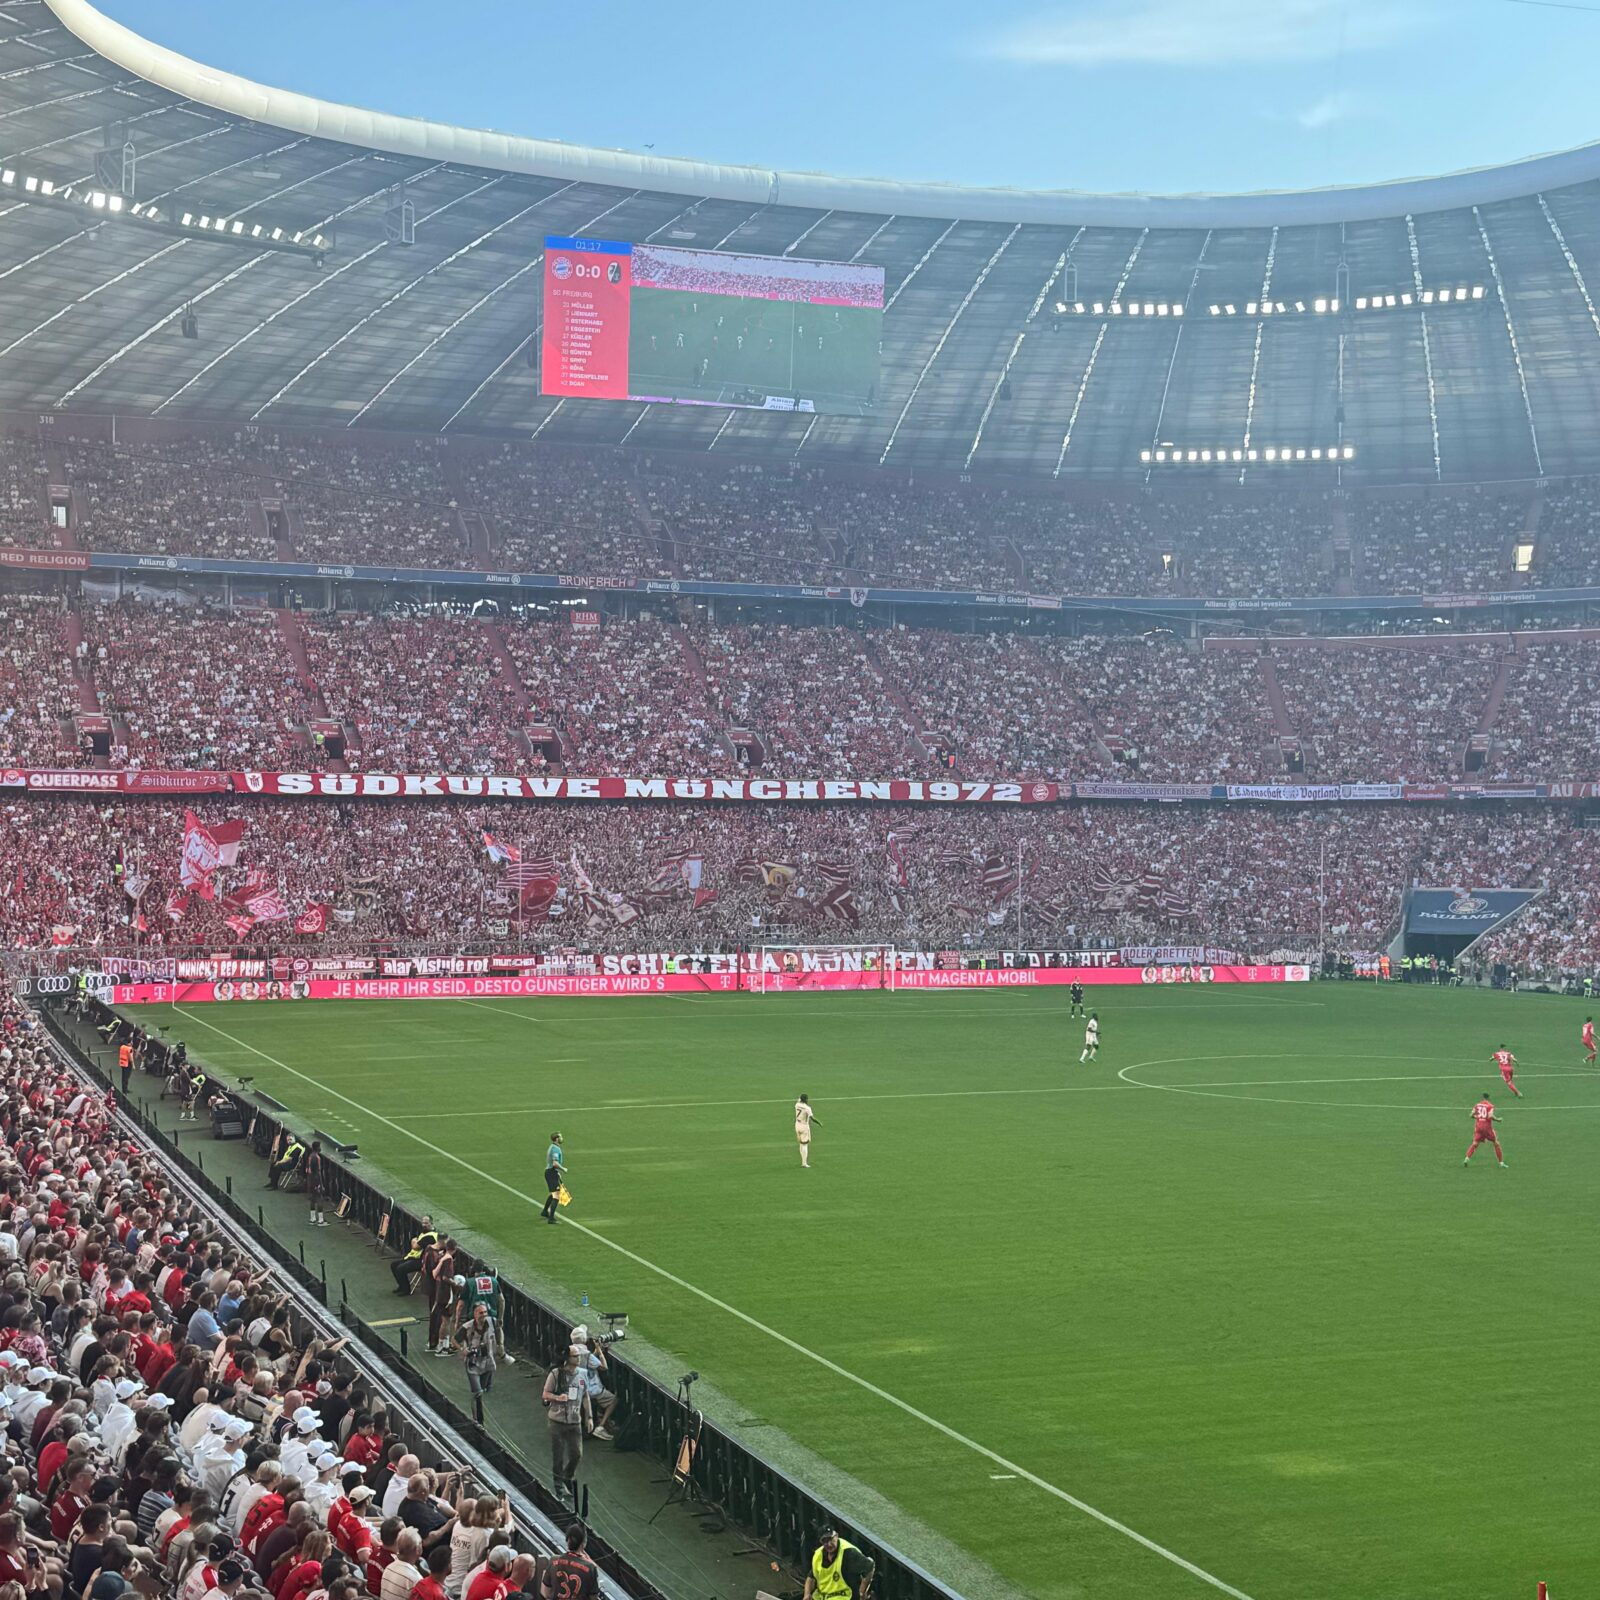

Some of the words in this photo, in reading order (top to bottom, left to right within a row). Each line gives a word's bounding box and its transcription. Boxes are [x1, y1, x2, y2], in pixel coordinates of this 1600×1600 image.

[576, 241, 601, 251] 01:17
[576, 264, 601, 278] 0:0
[0, 552, 24, 563] RED
[30, 555, 85, 566] RELIGION
[138, 558, 165, 567] Allianz
[317, 567, 343, 575] Allianz
[486, 574, 510, 583] Allianz
[647, 581, 670, 590] Allianz
[801, 588, 824, 596] Allianz
[976, 595, 997, 603] Allianz
[1007, 595, 1027, 604] Global
[1262, 600, 1292, 608] Investors
[30, 774, 118, 787] QUEERPASS
[277, 774, 600, 798] SÜDKURVE
[625, 779, 892, 800] MÜNCHEN
[908, 782, 1022, 802] 1972
[1550, 784, 1573, 797] AU
[1419, 912, 1500, 920] PAULANER
[1123, 948, 1152, 958] ADLER
[1157, 948, 1200, 958] BRETTEN
[1003, 953, 1040, 967] RD
[902, 973, 925, 985] MIT
[929, 972, 994, 985] MAGENTA
[998, 972, 1038, 983] MOBIL
[333, 983, 350, 996] JE
[356, 982, 399, 995] MEHR
[404, 982, 428, 994] IHR
[433, 981, 470, 995] SEID,
[475, 980, 522, 993] DESTO
[526, 978, 607, 992] GÜNSTIGER
[1477, 1107, 1487, 1118] 30
